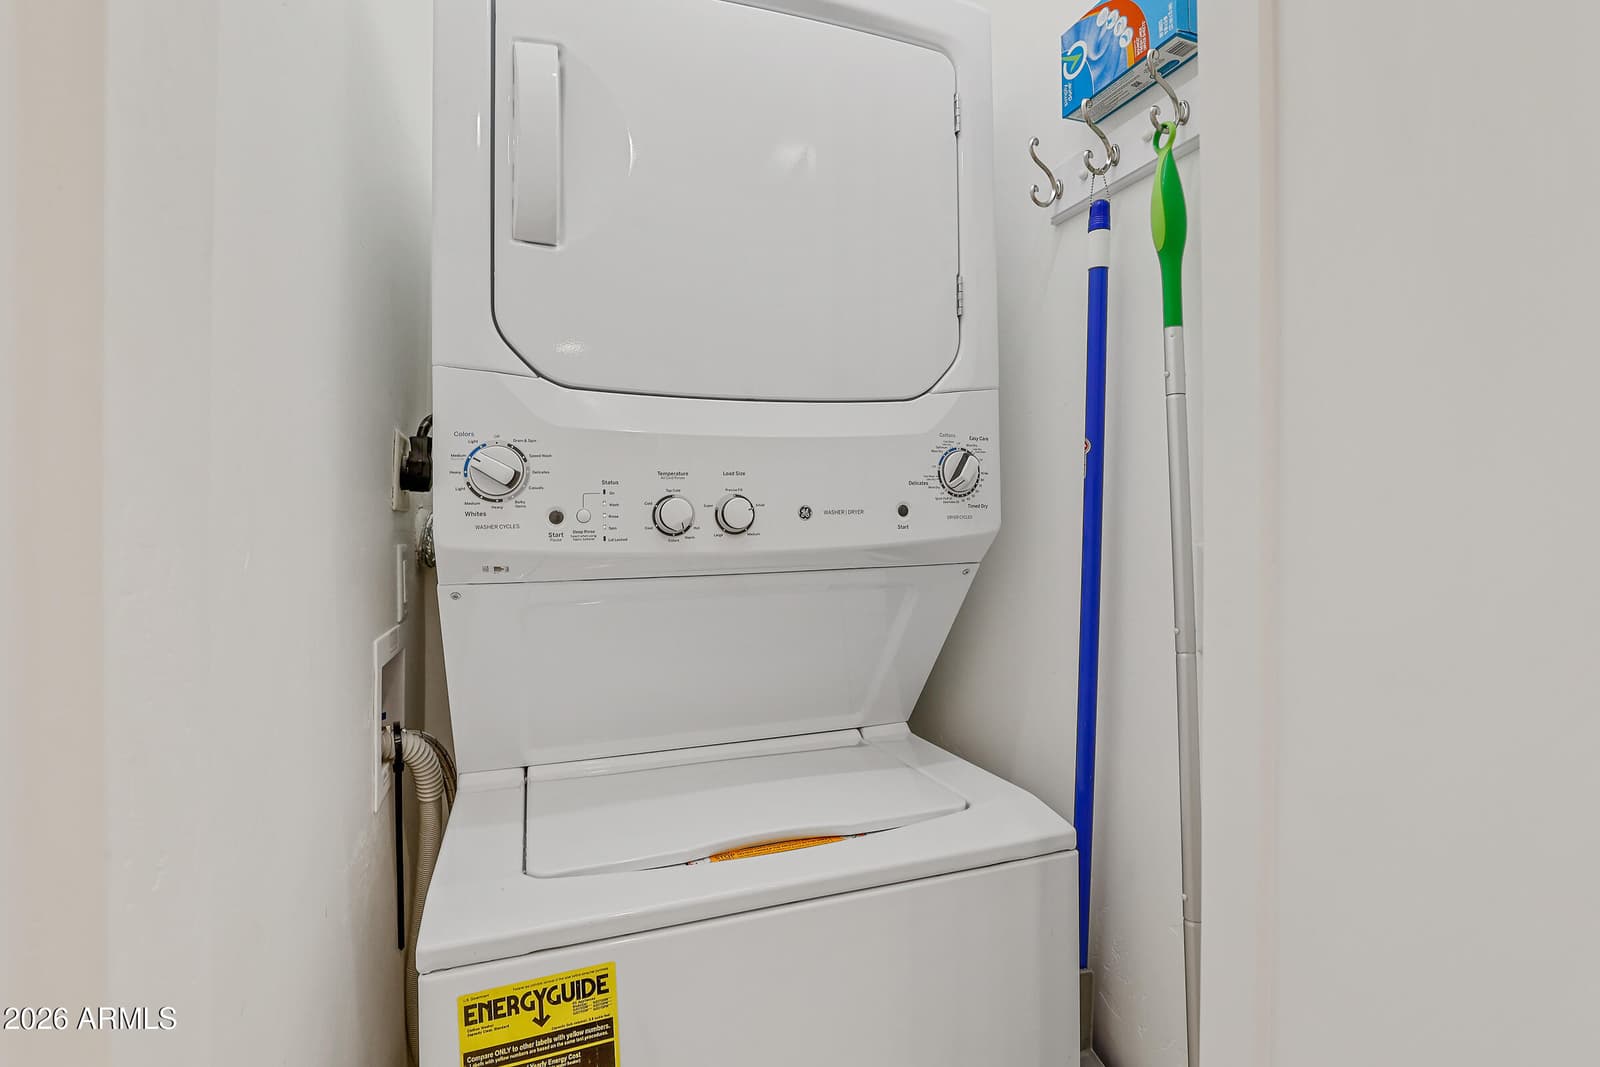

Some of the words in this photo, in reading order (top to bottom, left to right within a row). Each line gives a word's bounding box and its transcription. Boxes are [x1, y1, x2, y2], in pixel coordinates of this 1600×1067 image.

[464, 974, 610, 1027] ENERGYGUIDE
[466, 1052, 494, 1064] Compare
[494, 1046, 511, 1057] ONLY
[520, 1042, 534, 1050] other
[536, 1037, 553, 1047] labels
[553, 1033, 566, 1042] with
[566, 1029, 584, 1040] yellow
[585, 1023, 611, 1035] numbers.
[548, 1056, 567, 1066] Energy
[568, 1051, 581, 1060] Cost
